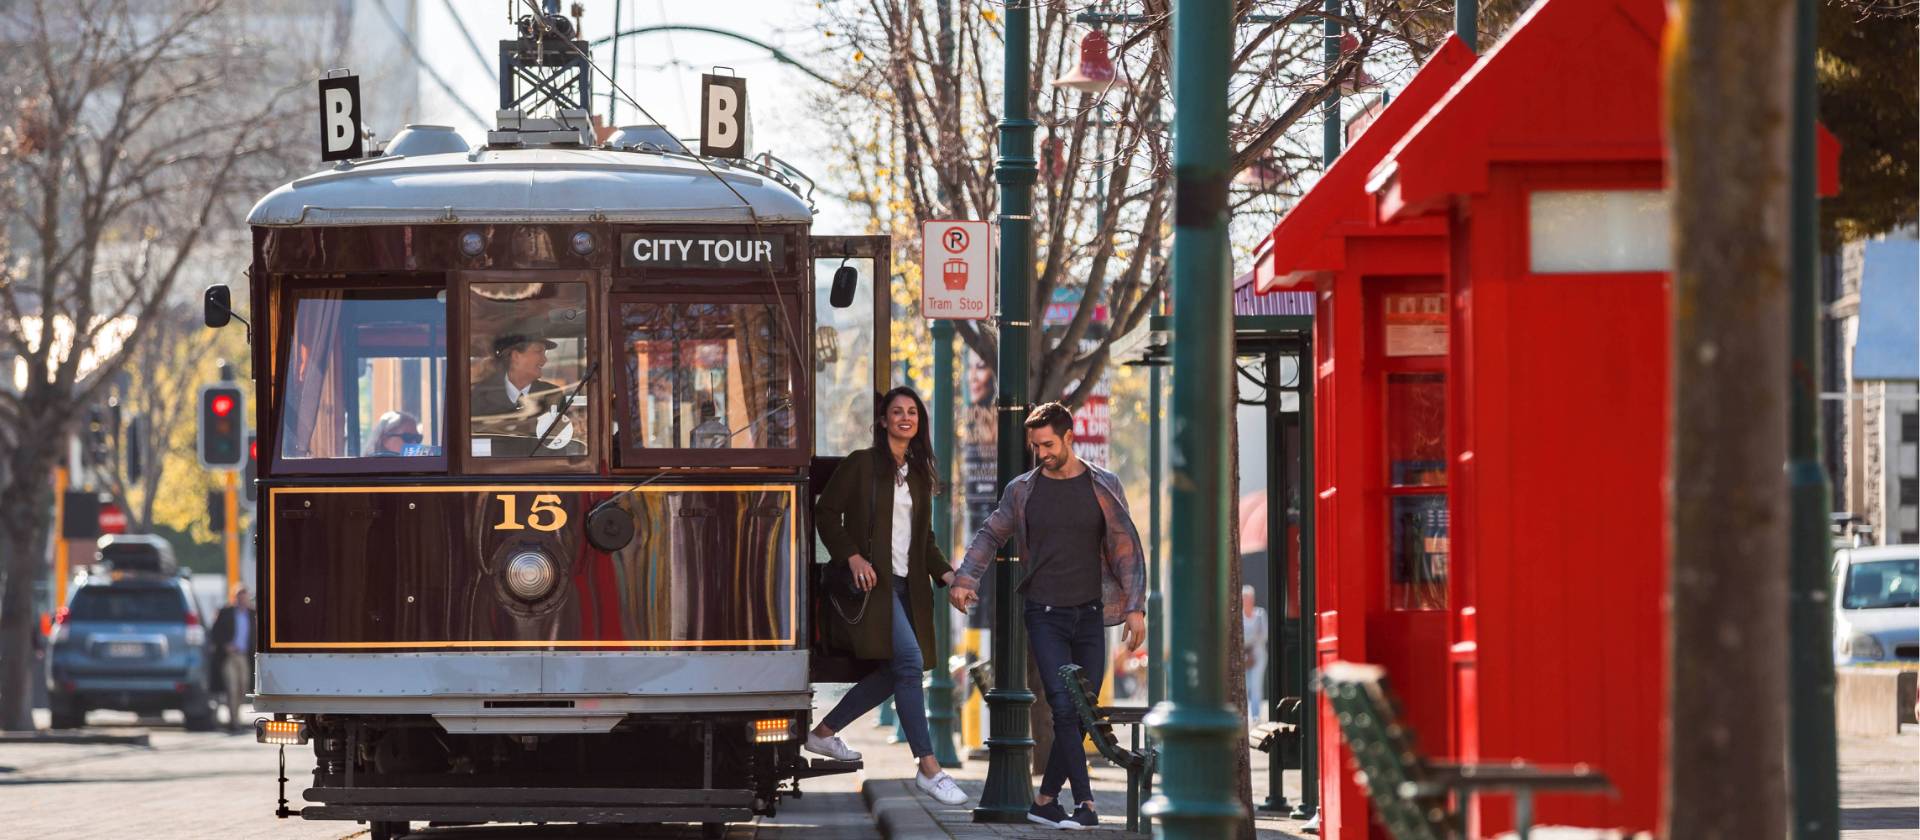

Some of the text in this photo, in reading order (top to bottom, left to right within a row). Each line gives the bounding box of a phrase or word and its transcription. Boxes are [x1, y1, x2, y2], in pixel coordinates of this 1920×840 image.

[325, 87, 355, 153] B
[708, 84, 739, 149] B
[633, 238, 772, 263] CITY TOUR
[951, 231, 962, 249] P
[928, 296, 984, 311] Tram Stop
[494, 494, 568, 531] 15
